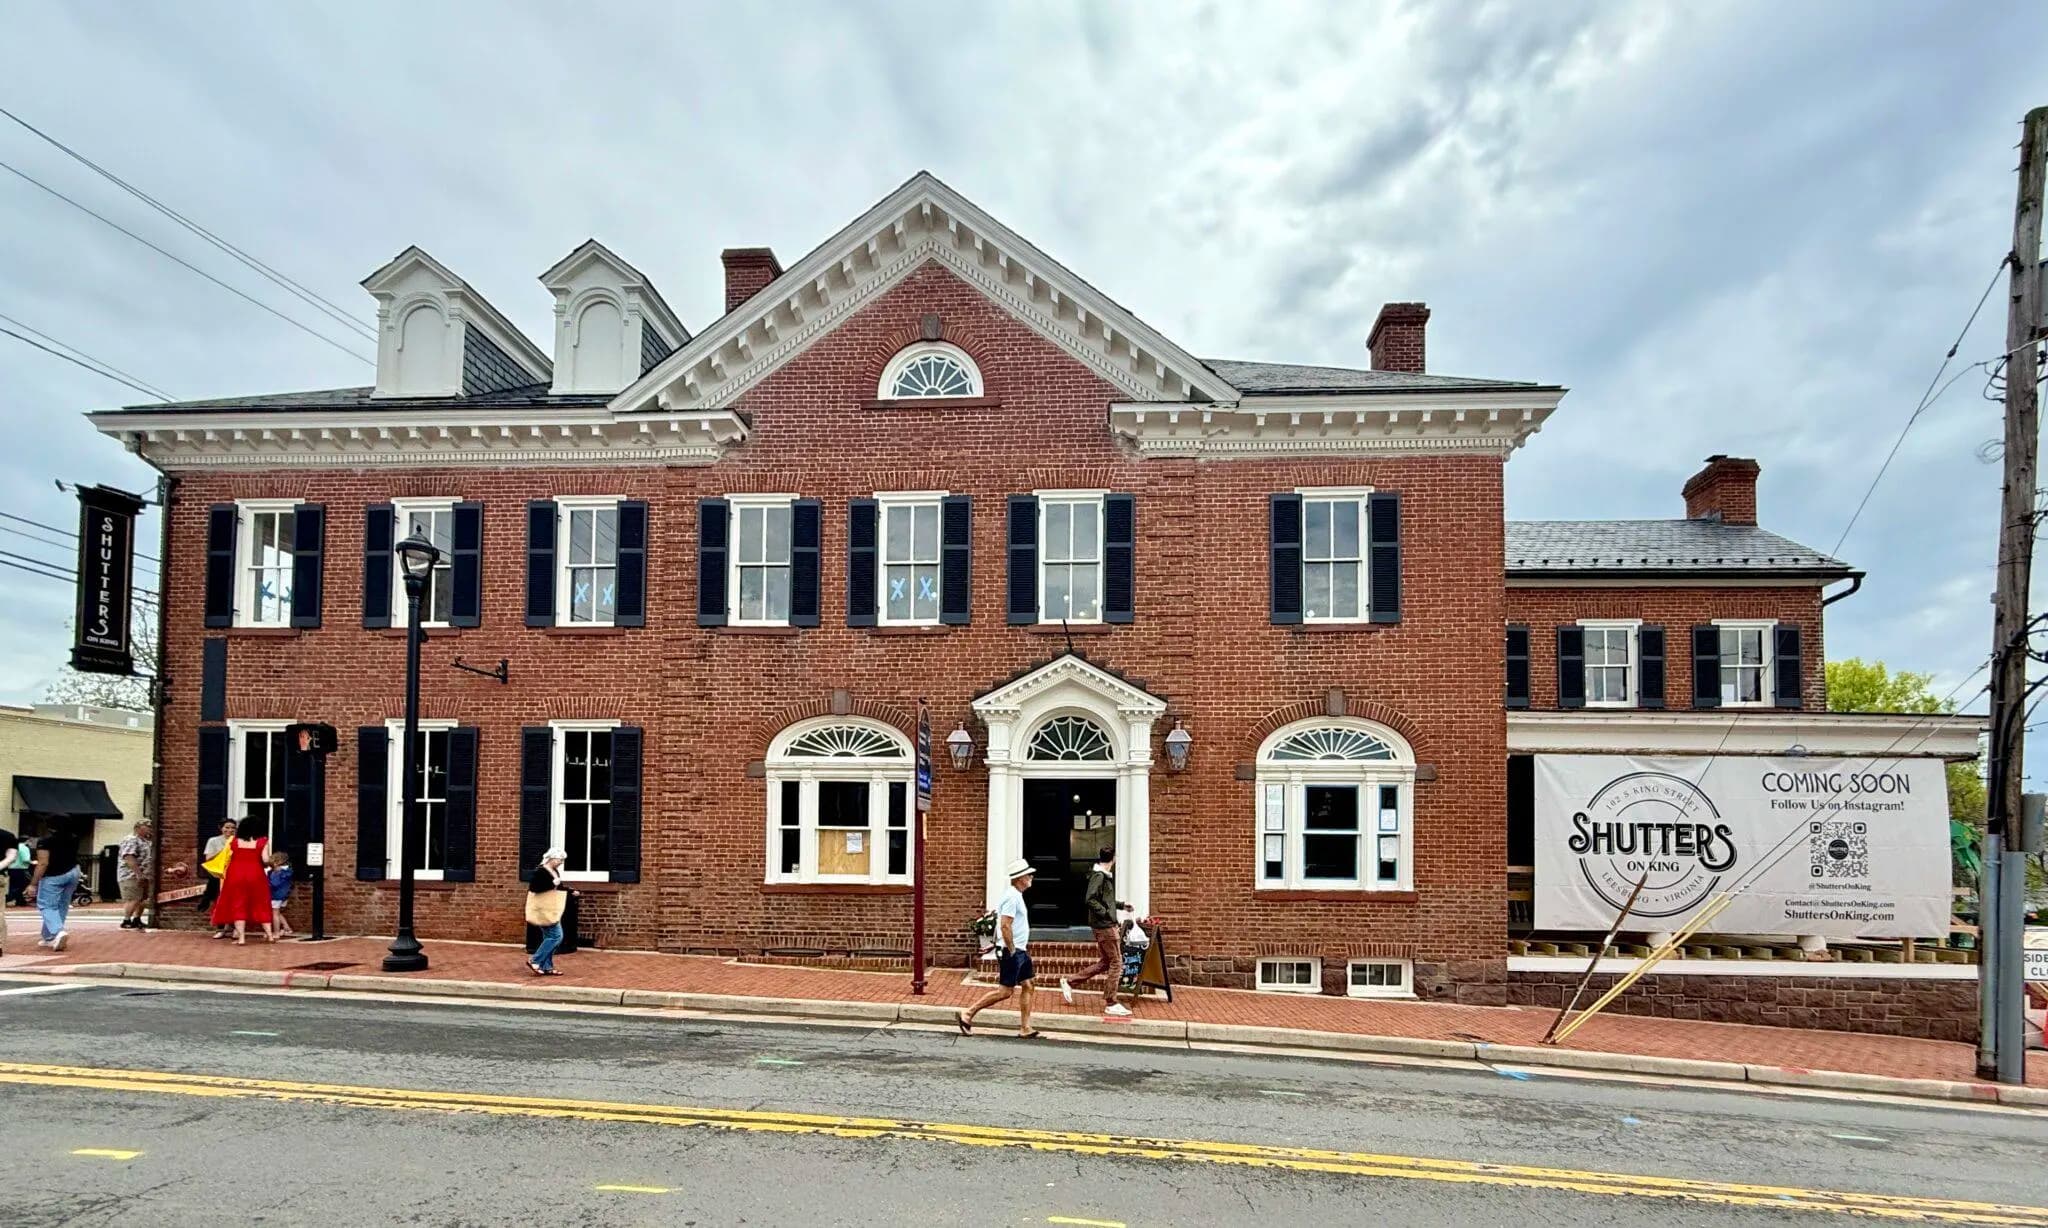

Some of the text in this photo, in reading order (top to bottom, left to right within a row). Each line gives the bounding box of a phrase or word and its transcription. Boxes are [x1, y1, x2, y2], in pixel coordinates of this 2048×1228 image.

[89, 516, 113, 636] SHUTTERS
[1633, 785, 1660, 794] KING
[1762, 772, 1911, 794] COMING SOON
[1770, 799, 1905, 813] Follow Us on Instagram!
[1568, 811, 1737, 872] SHUTTERS
[1627, 860, 1680, 873] ON KING
[1664, 875, 1705, 903] VIRGINIA
[1808, 882, 1872, 892] @ShuttersOnKing
[1783, 909, 1895, 923] ShuttersOnKing.com
